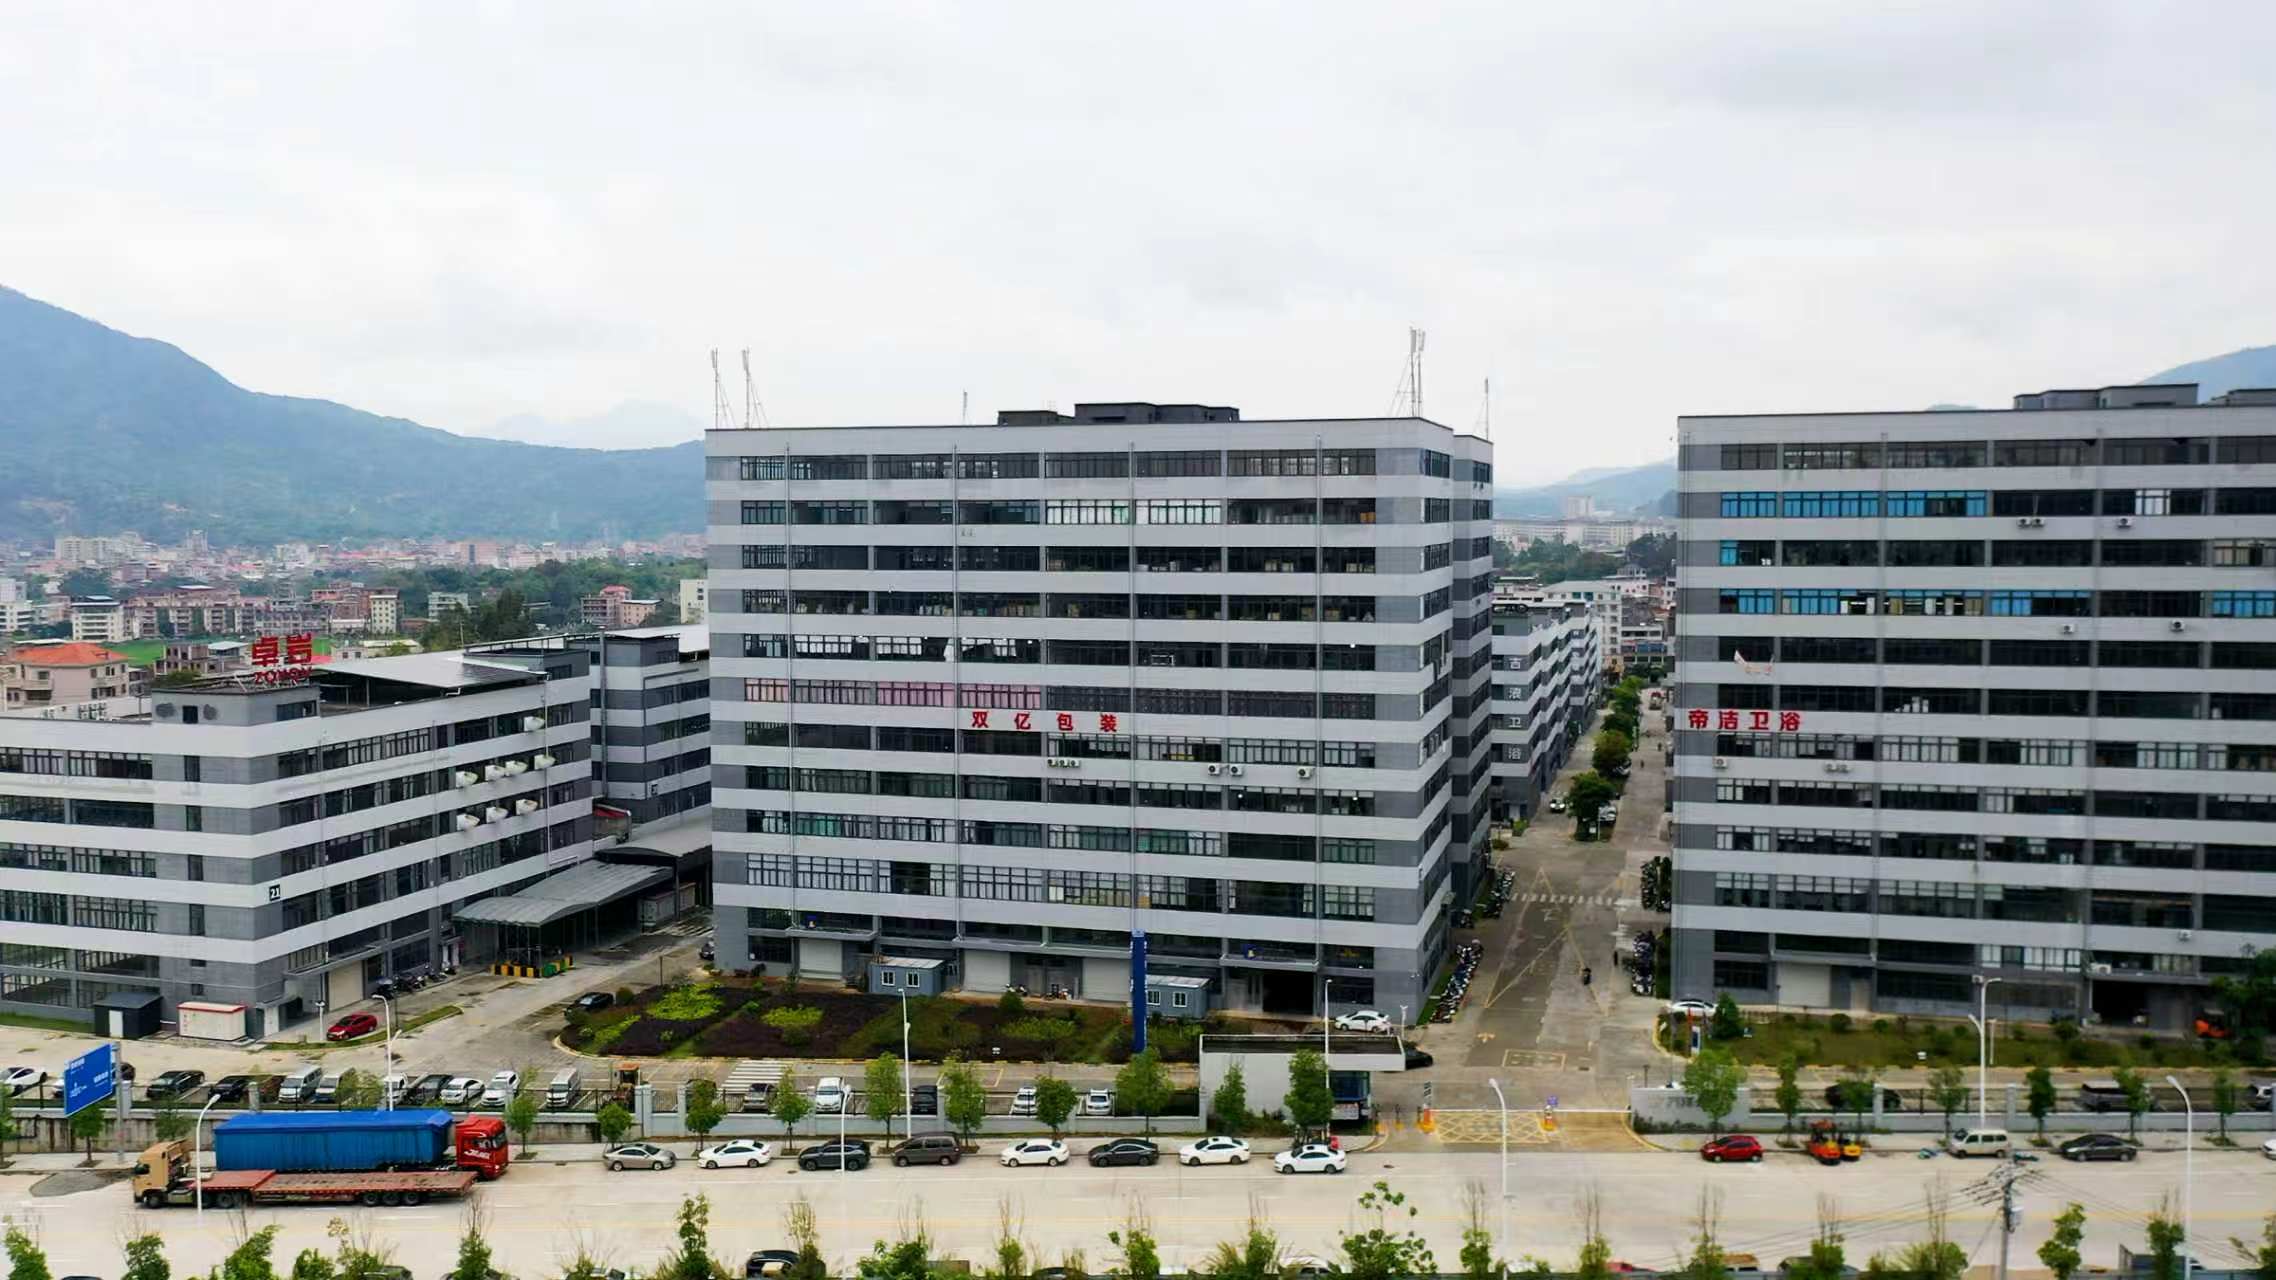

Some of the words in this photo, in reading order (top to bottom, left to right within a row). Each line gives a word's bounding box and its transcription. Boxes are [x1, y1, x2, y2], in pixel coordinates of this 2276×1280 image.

[972, 711, 1118, 732] 双亿包装
[1688, 708, 1801, 731] 帝洁卫浴
